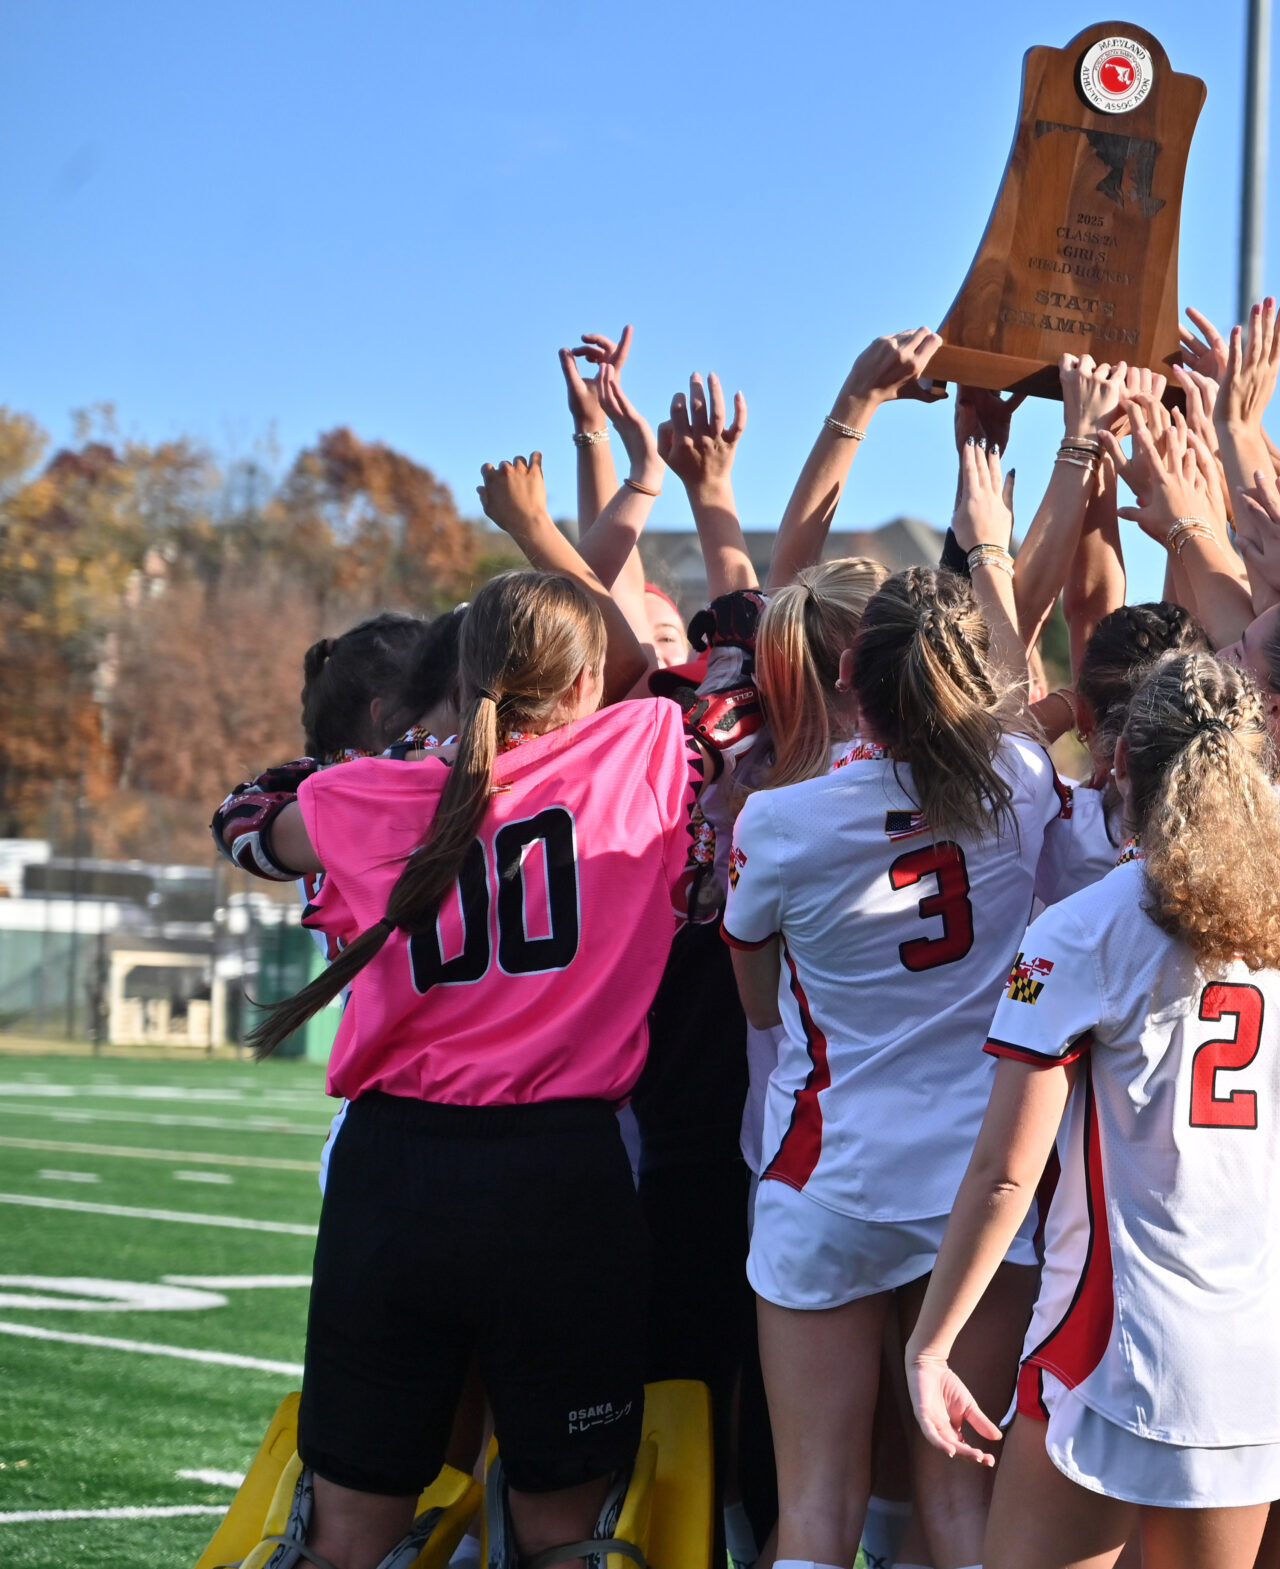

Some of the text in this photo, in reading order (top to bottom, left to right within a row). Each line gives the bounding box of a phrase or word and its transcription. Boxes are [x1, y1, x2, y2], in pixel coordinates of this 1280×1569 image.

[1098, 38, 1146, 60] MARYLAND
[1105, 78, 1150, 110] ASSOCATION
[1077, 213, 1104, 227] 2025
[1056, 226, 1100, 244] CLASS
[1028, 256, 1072, 274] FIELD
[1063, 245, 1106, 262] GIRLS
[1035, 290, 1115, 317] STATE
[1000, 308, 1139, 344] CHAMPION
[407, 804, 581, 997] 00
[888, 840, 975, 972] 3
[1189, 981, 1264, 1130] 2
[568, 1402, 613, 1422] OSAKA
